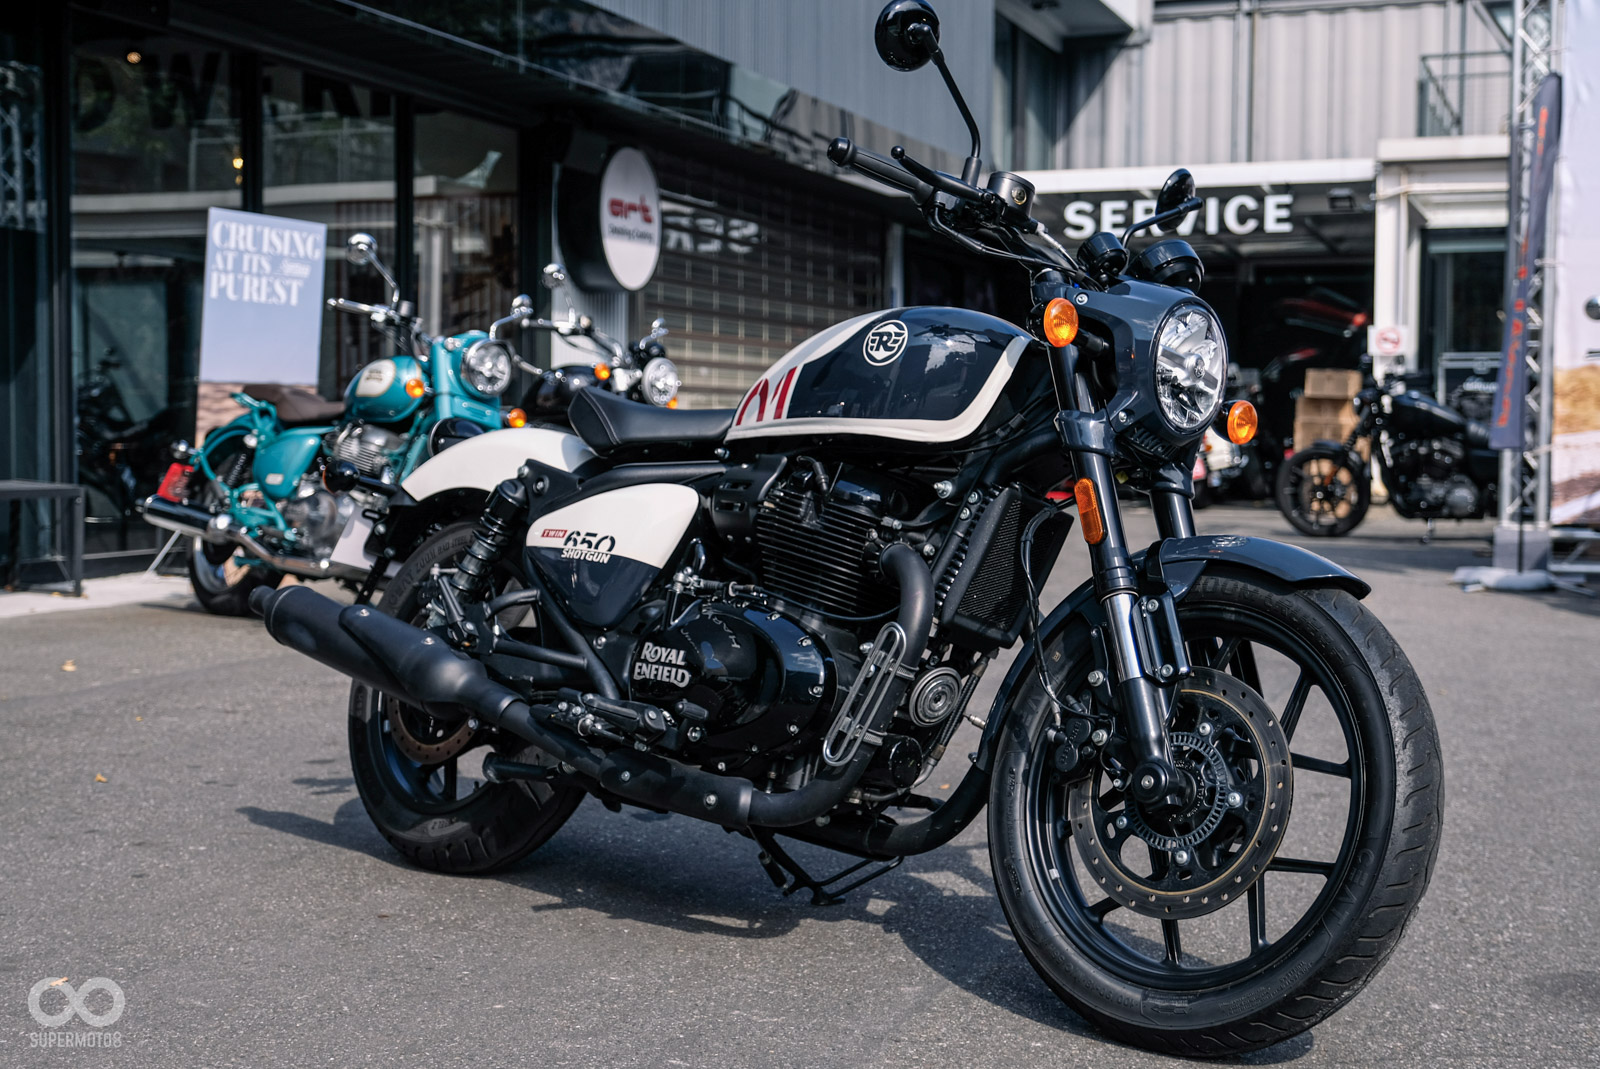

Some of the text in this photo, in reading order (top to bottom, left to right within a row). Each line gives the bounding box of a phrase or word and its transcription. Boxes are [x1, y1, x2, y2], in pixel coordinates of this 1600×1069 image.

[211, 220, 321, 261] CRUISING
[212, 250, 238, 272] AT
[242, 253, 272, 275] ITS
[209, 270, 304, 307] PUREST
[563, 530, 616, 552] 650
[561, 548, 611, 564] SHOTGUN
[641, 641, 687, 666] ROYAL
[633, 662, 692, 688] ENFIELD
